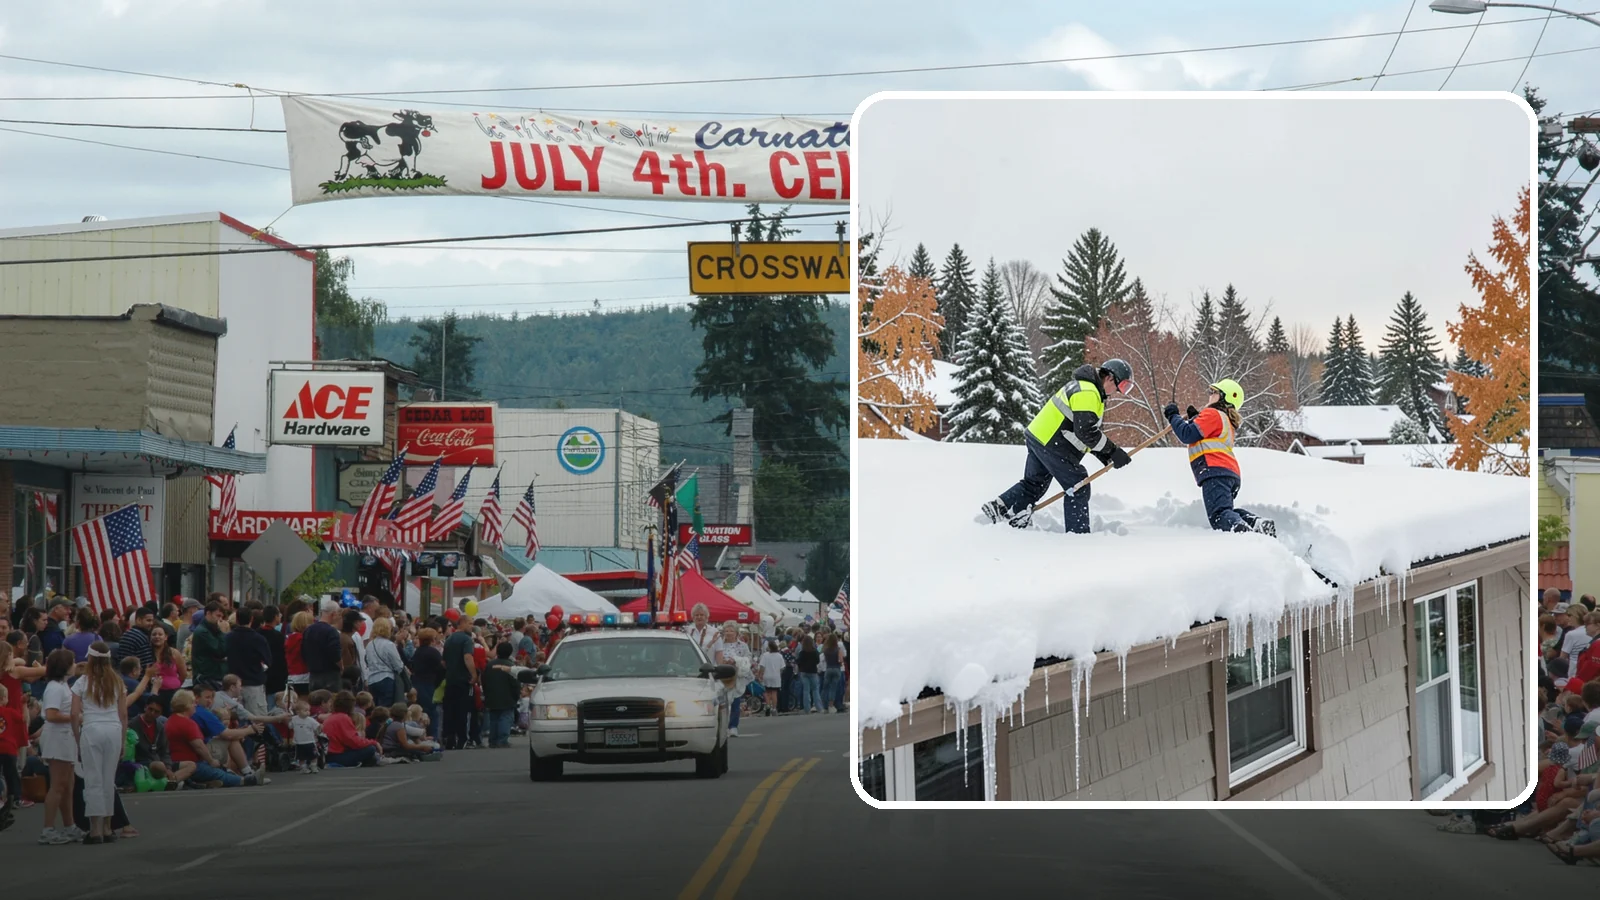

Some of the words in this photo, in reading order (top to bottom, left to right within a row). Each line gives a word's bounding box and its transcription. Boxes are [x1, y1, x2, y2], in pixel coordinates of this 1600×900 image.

[481, 141, 605, 192] JULY
[632, 150, 746, 197] 4th.
[697, 254, 850, 279] CROSSWA
[283, 380, 373, 420] ACE
[405, 409, 452, 422] CEDAR
[283, 421, 371, 436] Hardware
[353, 467, 386, 480] Simpl
[83, 484, 93, 494] St.
[95, 484, 124, 495] Vincent
[126, 486, 136, 495] de
[137, 486, 155, 495] Paul
[81, 503, 154, 522] THT
[688, 526, 741, 535] CRNATION
[698, 535, 730, 543] GLASS
